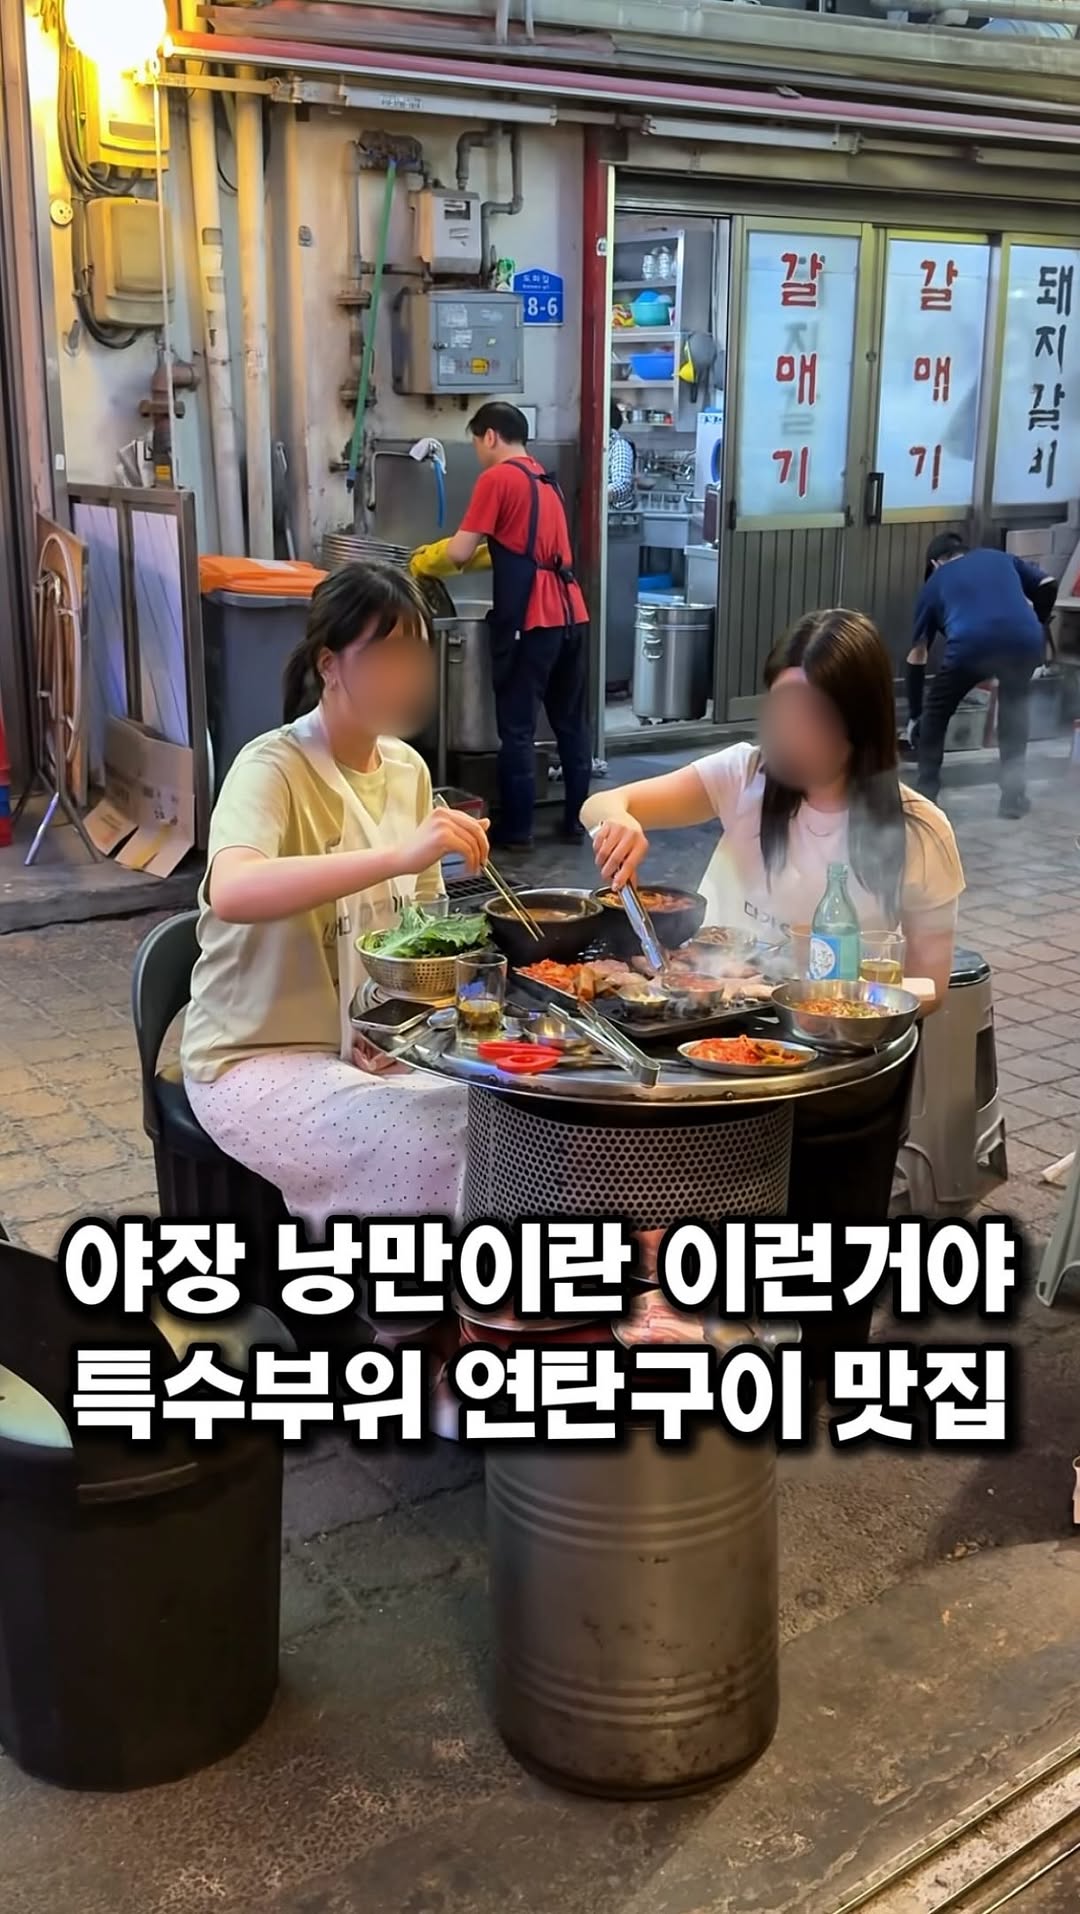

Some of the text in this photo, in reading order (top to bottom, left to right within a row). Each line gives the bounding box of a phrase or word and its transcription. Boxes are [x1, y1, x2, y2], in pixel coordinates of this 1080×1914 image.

[521, 296, 558, 317] 8-6
[771, 252, 824, 498] 갈매기
[909, 259, 960, 492] 갈매기
